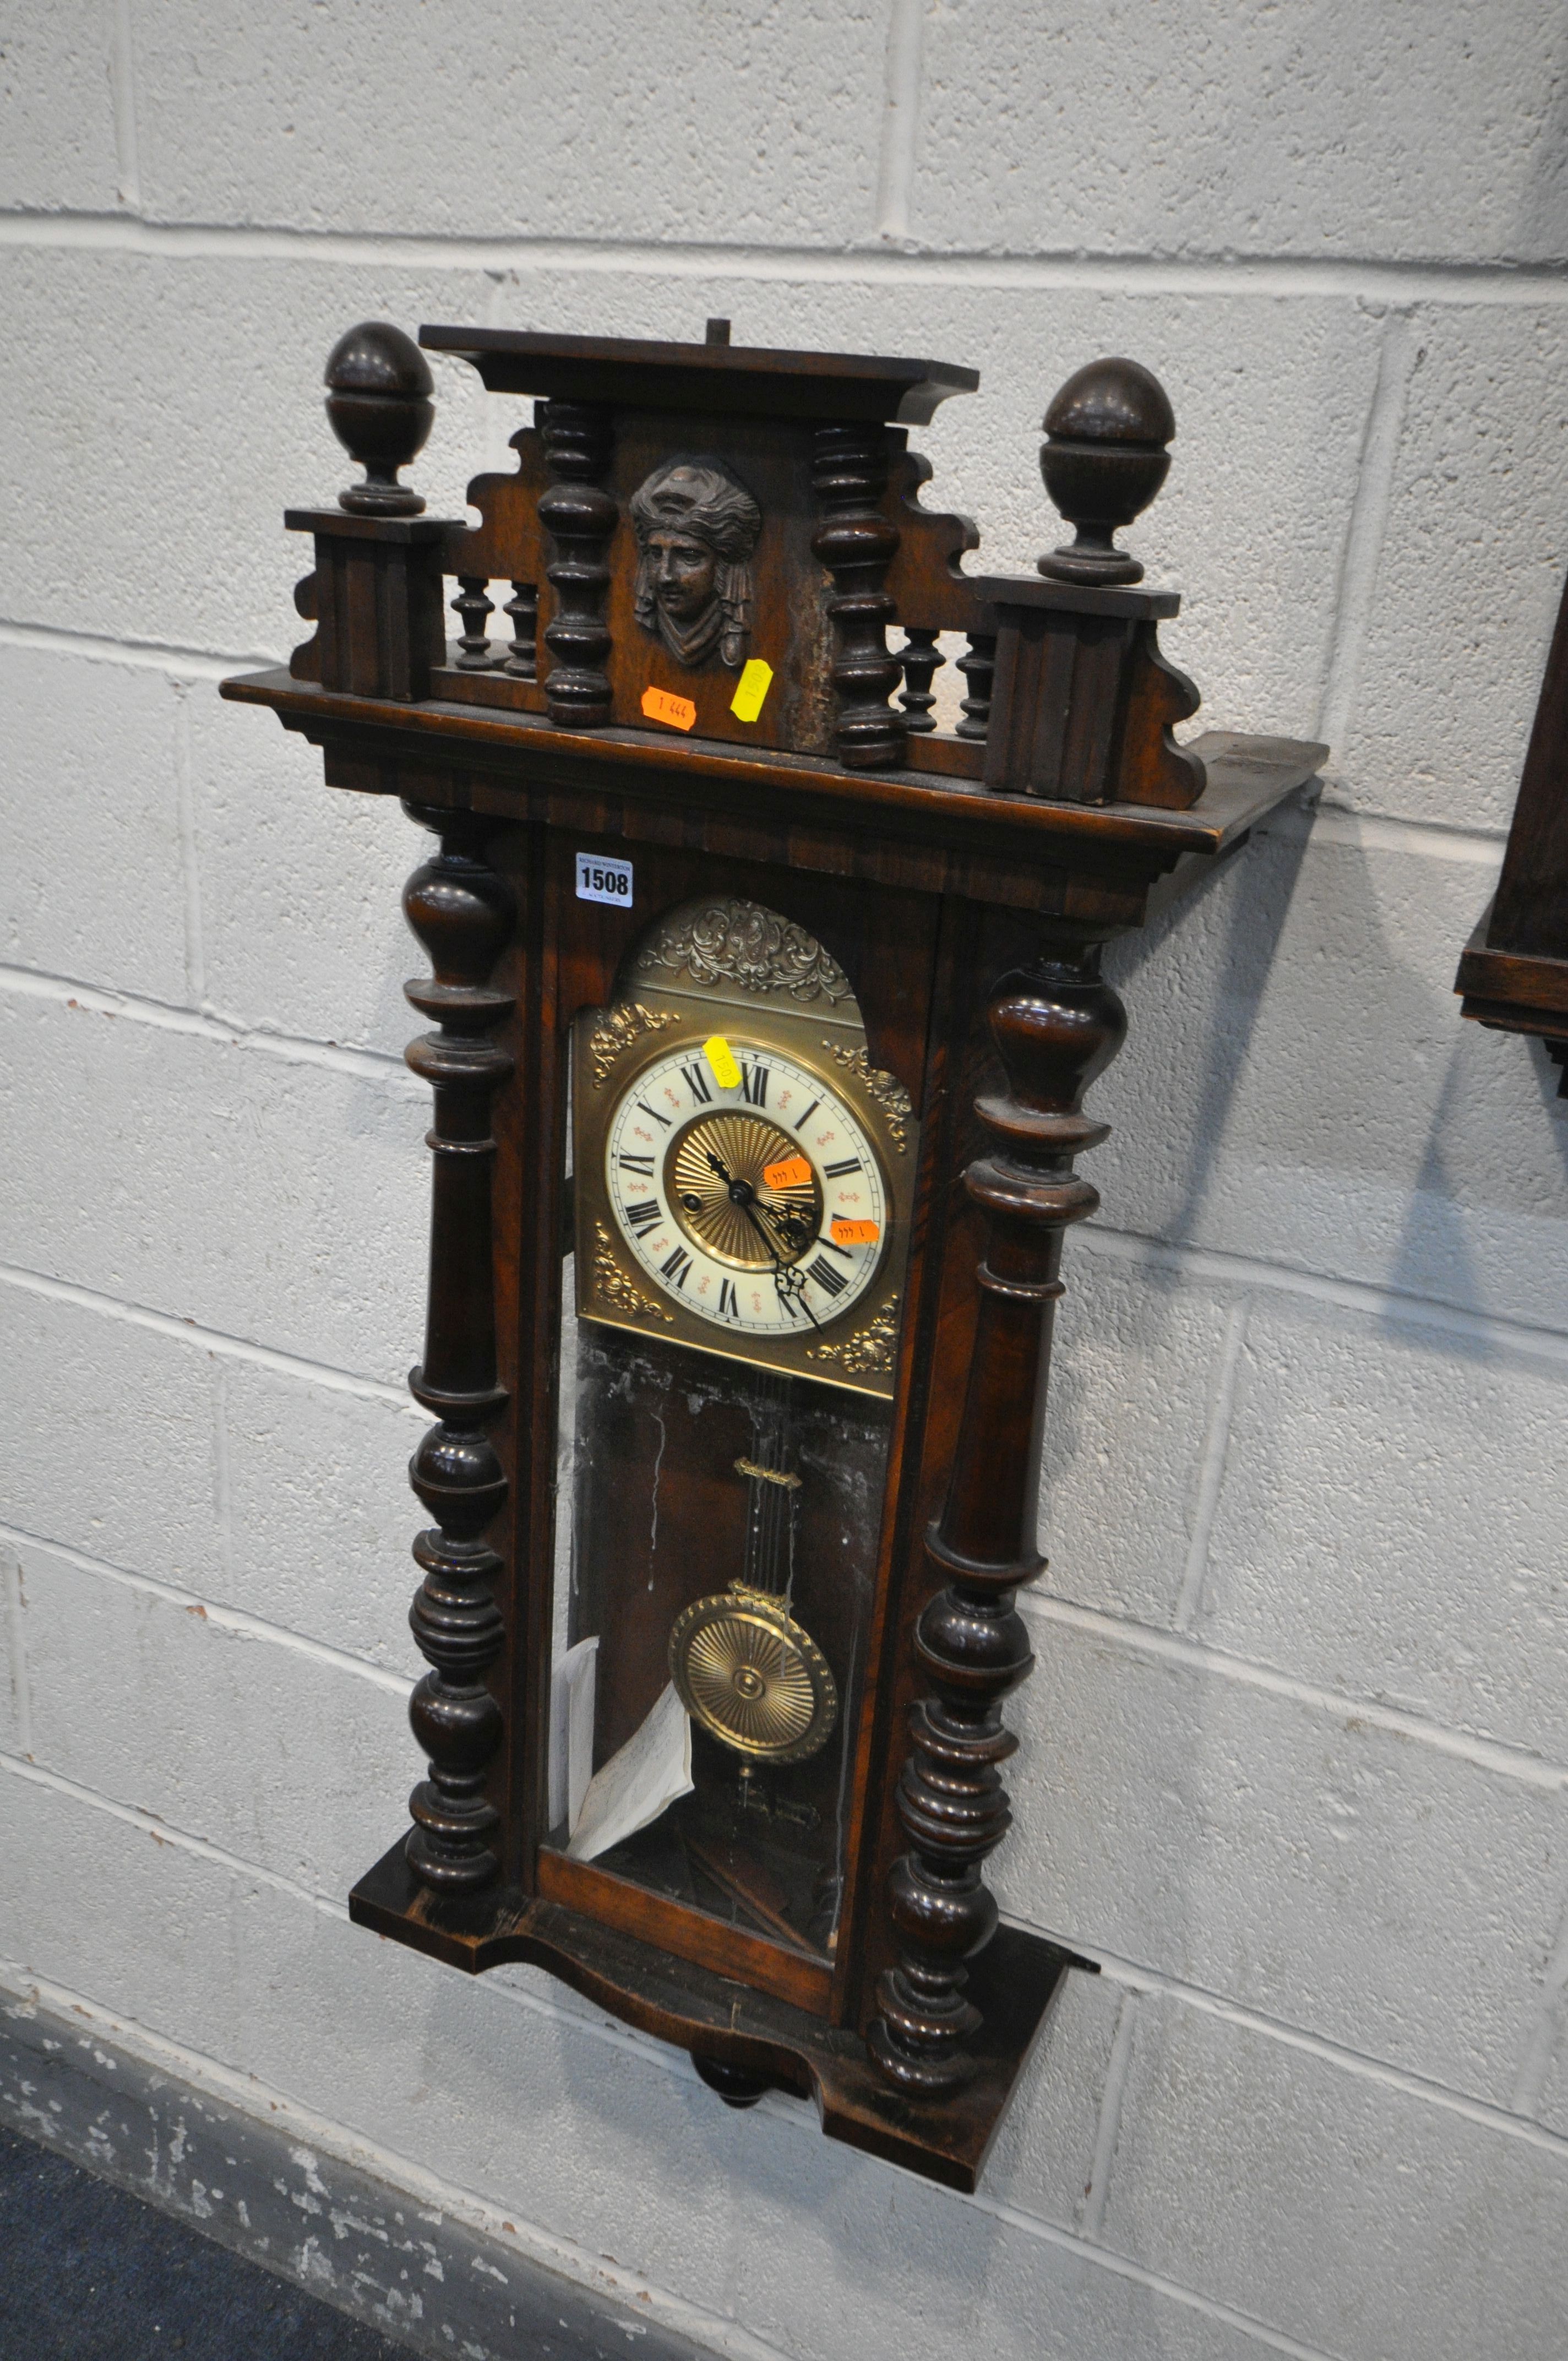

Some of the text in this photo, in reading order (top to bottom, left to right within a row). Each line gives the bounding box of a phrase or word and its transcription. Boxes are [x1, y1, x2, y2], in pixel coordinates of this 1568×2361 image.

[745, 663, 766, 698] 1508
[581, 867, 628, 895] 1508
[679, 1062, 713, 1107] XI
[736, 1062, 770, 1109] XII
[637, 1094, 673, 1133] X
[823, 1157, 863, 1180] II
[624, 1198, 665, 1239] VIII
[660, 1244, 694, 1290] VII
[718, 1277, 740, 1318] VI
